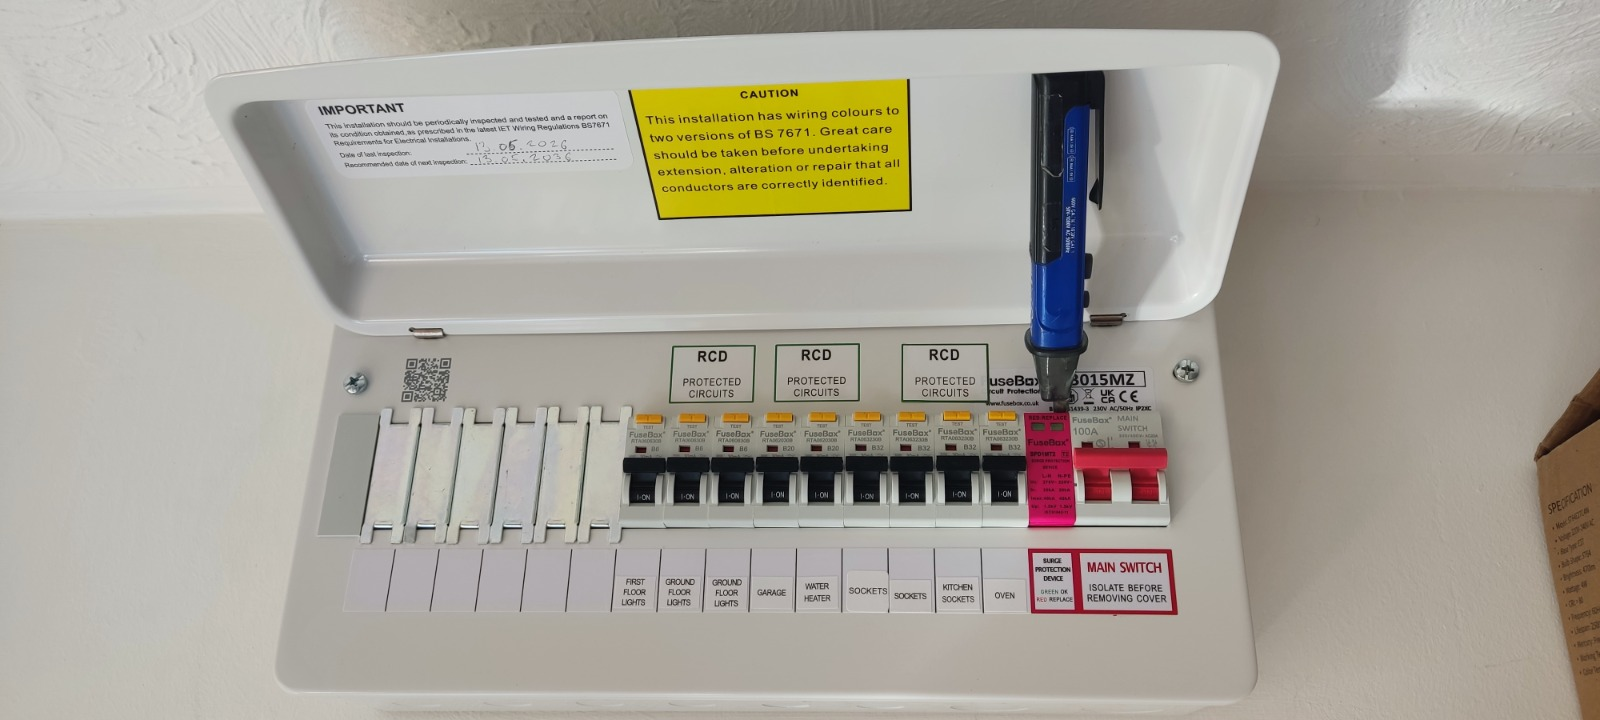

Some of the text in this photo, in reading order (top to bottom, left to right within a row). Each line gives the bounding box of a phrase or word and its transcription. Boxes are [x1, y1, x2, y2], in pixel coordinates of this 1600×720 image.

[740, 89, 799, 100] CAUTION
[318, 103, 404, 116] IMPORTANT
[646, 106, 900, 126] This installation has wiring colours to
[425, 118, 468, 127] periodically
[470, 118, 506, 126] inspected
[418, 128, 455, 136] prescribed
[537, 123, 580, 131] Regulations
[650, 126, 892, 143] two versions of BS 7671. Great care
[428, 136, 472, 144] Installations.
[654, 142, 888, 160] should be taken before undertaking
[344, 160, 394, 168] Recommended
[433, 158, 468, 166] inspection:
[658, 159, 900, 178] extension, alteration or repair that all
[662, 176, 888, 193] conductors are correctly identified.
[697, 350, 728, 362] RCD
[801, 348, 832, 361] RCD
[929, 348, 960, 361] RCD
[682, 378, 742, 387] PROTECTED
[787, 376, 846, 386] PROTECTED
[915, 376, 976, 386] PROTECTED
[688, 389, 734, 398] CIRCUITS
[794, 388, 840, 397] CIRCUITS
[922, 388, 969, 398] CIRCUITS
[716, 430, 751, 438] FuseBox
[1087, 562, 1162, 574] MAIN SWITCH
[848, 586, 888, 595] SOCKETS
[1089, 584, 1163, 592] ISOLATE BEFORE
[804, 594, 830, 602] HEATER
[1087, 594, 1168, 603] REMOVING COVER
